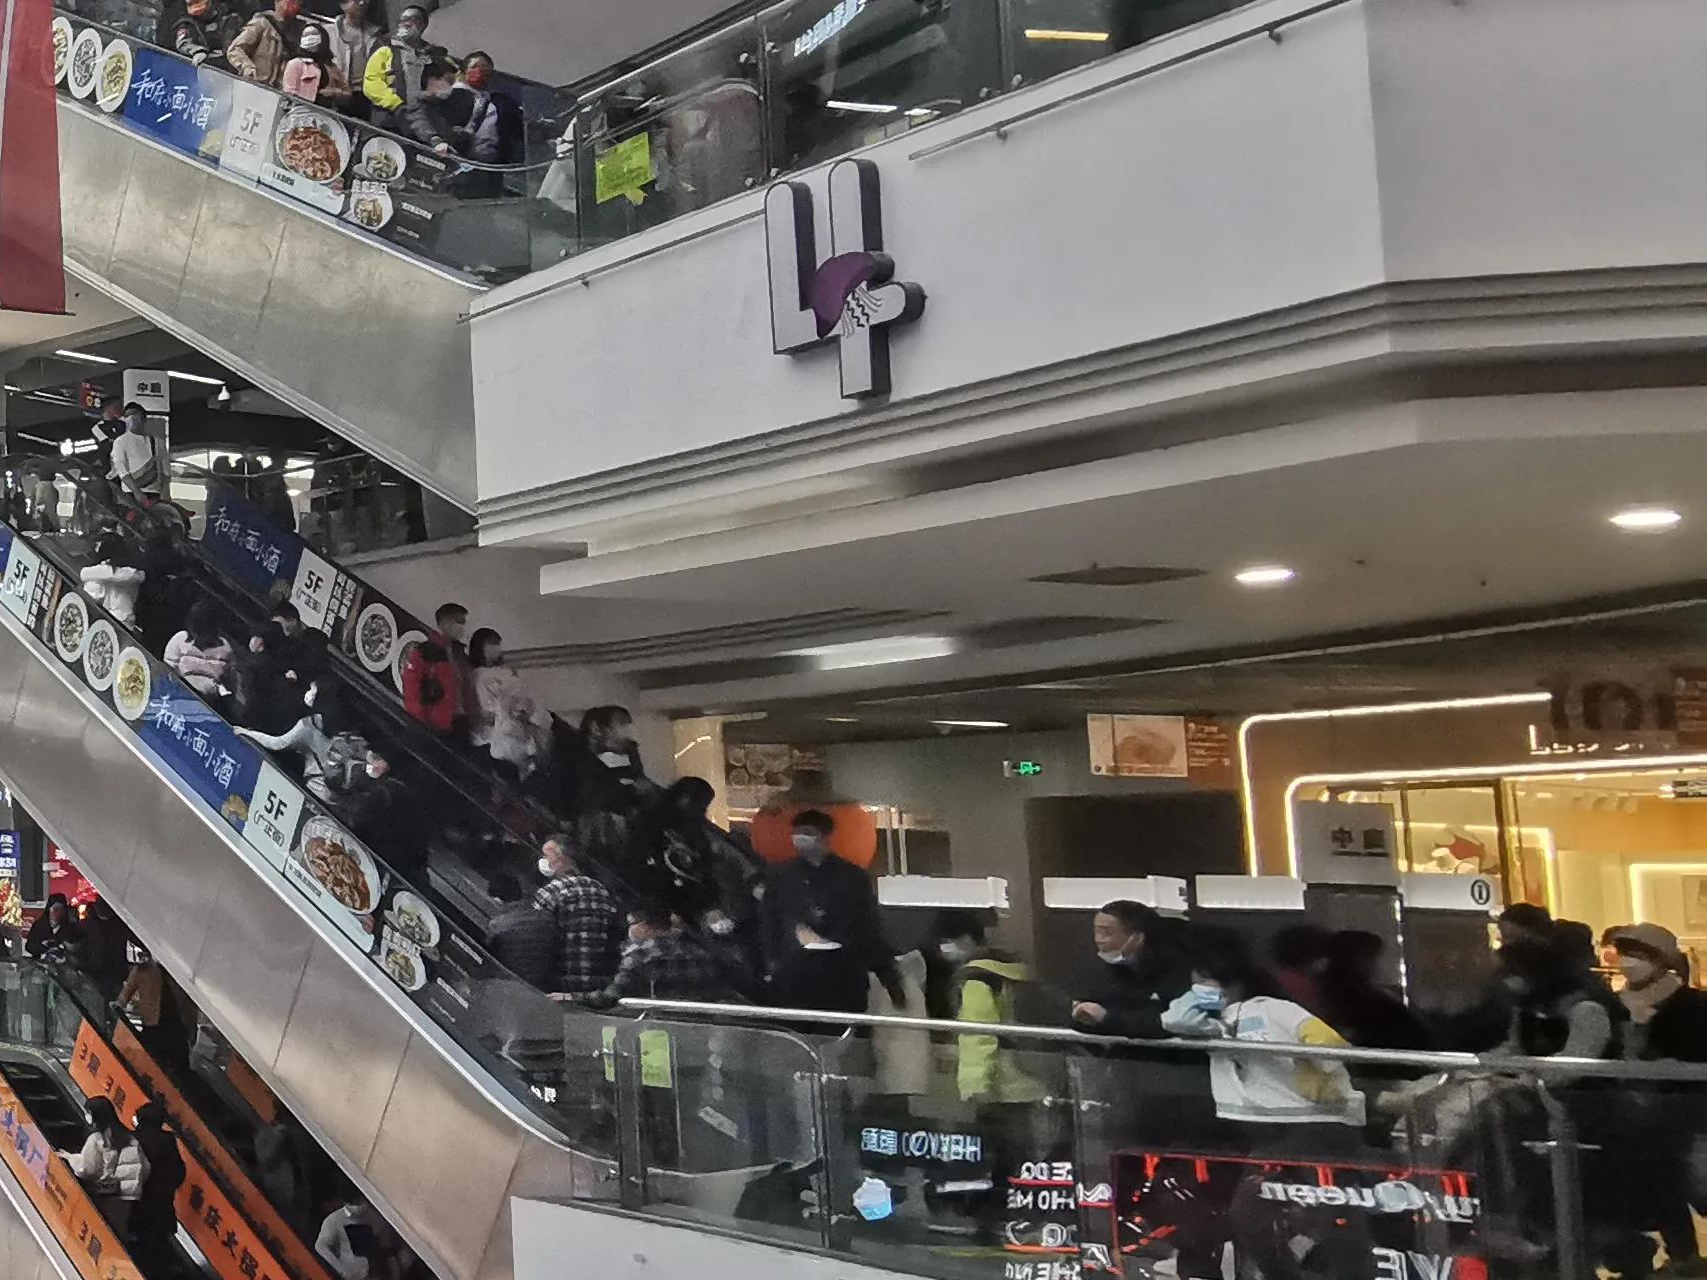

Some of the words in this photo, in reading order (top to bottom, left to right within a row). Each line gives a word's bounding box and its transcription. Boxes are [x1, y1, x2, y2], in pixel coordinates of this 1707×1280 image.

[239, 108, 263, 135] 5F
[765, 159, 928, 401] 4
[304, 569, 324, 594] 5F
[263, 789, 288, 821] 5F
